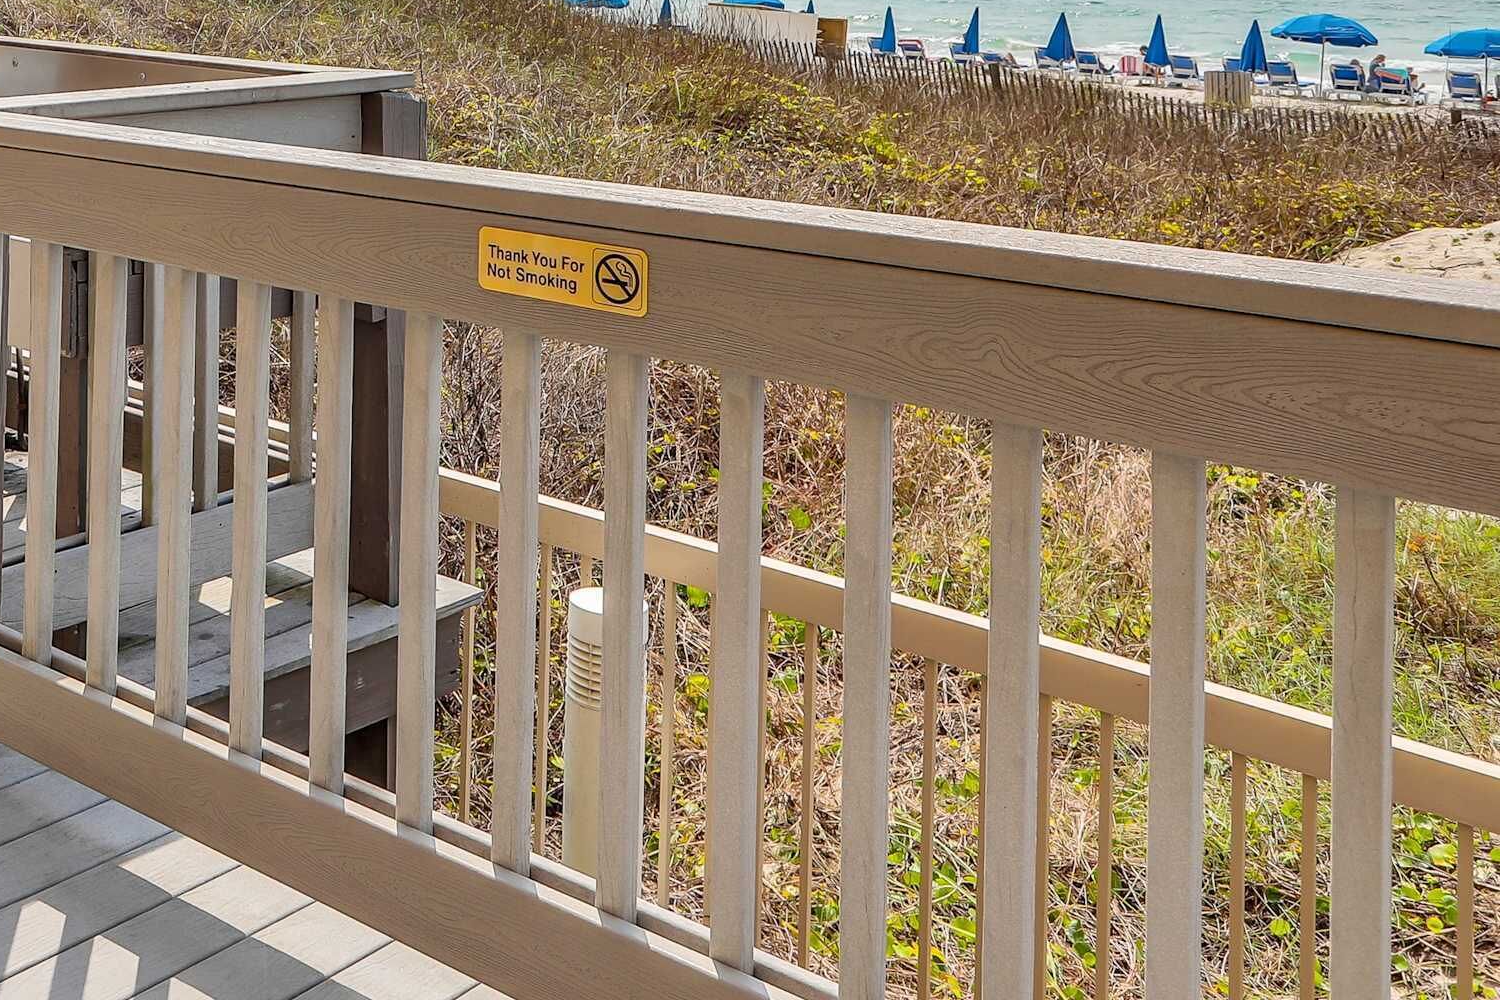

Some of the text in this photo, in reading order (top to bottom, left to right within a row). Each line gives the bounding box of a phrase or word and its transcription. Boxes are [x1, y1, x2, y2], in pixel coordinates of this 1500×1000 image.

[488, 244, 585, 273] Thank You For
[487, 263, 578, 294] Not Smoking
